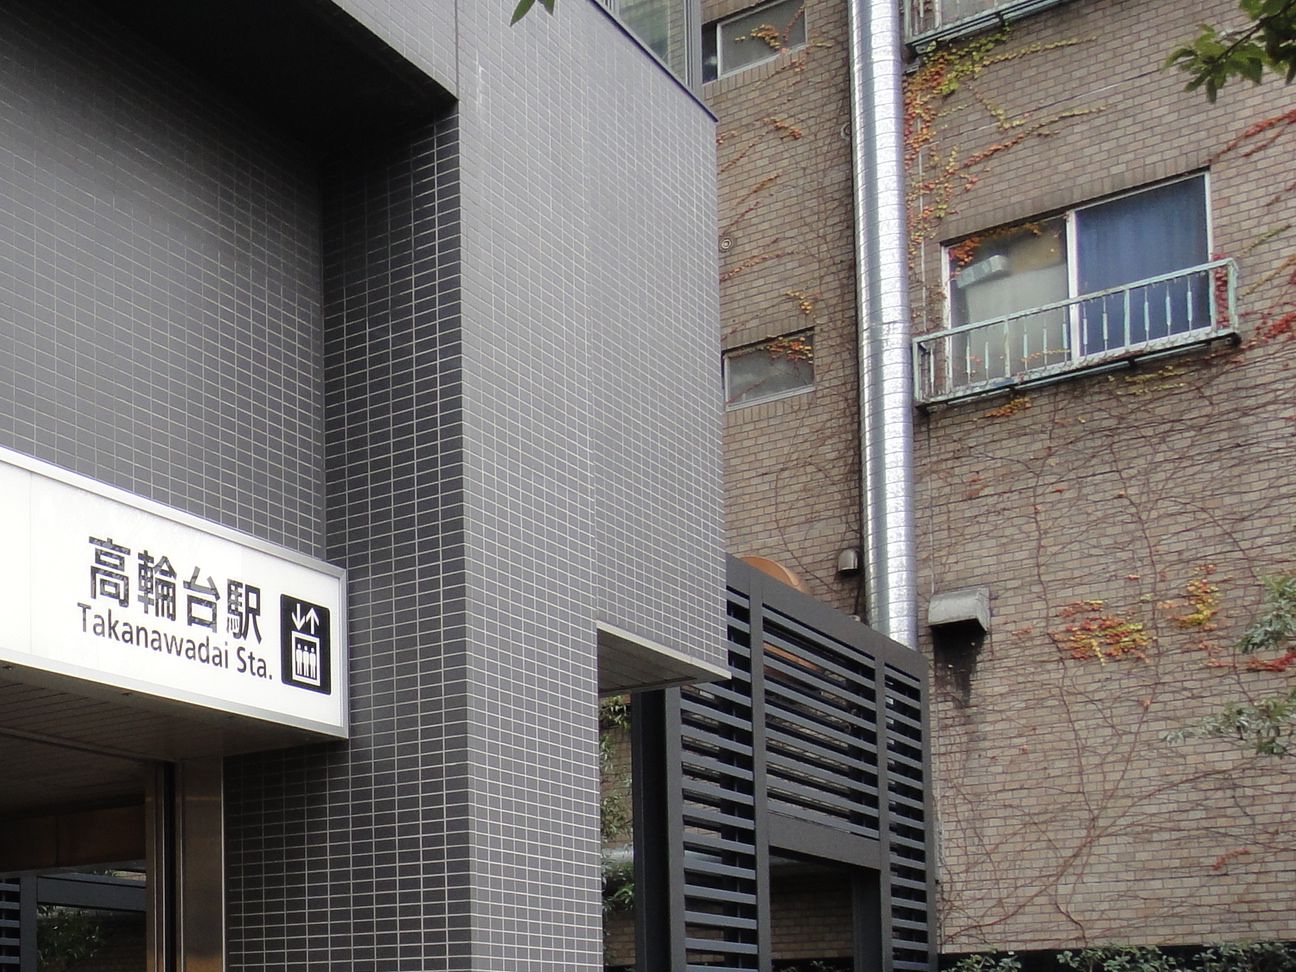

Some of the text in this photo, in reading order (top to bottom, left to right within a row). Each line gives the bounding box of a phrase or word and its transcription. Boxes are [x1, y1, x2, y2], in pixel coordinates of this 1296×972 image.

[88, 535, 263, 645] 高輪台駅
[77, 601, 273, 680] Takanawadai Sta.
